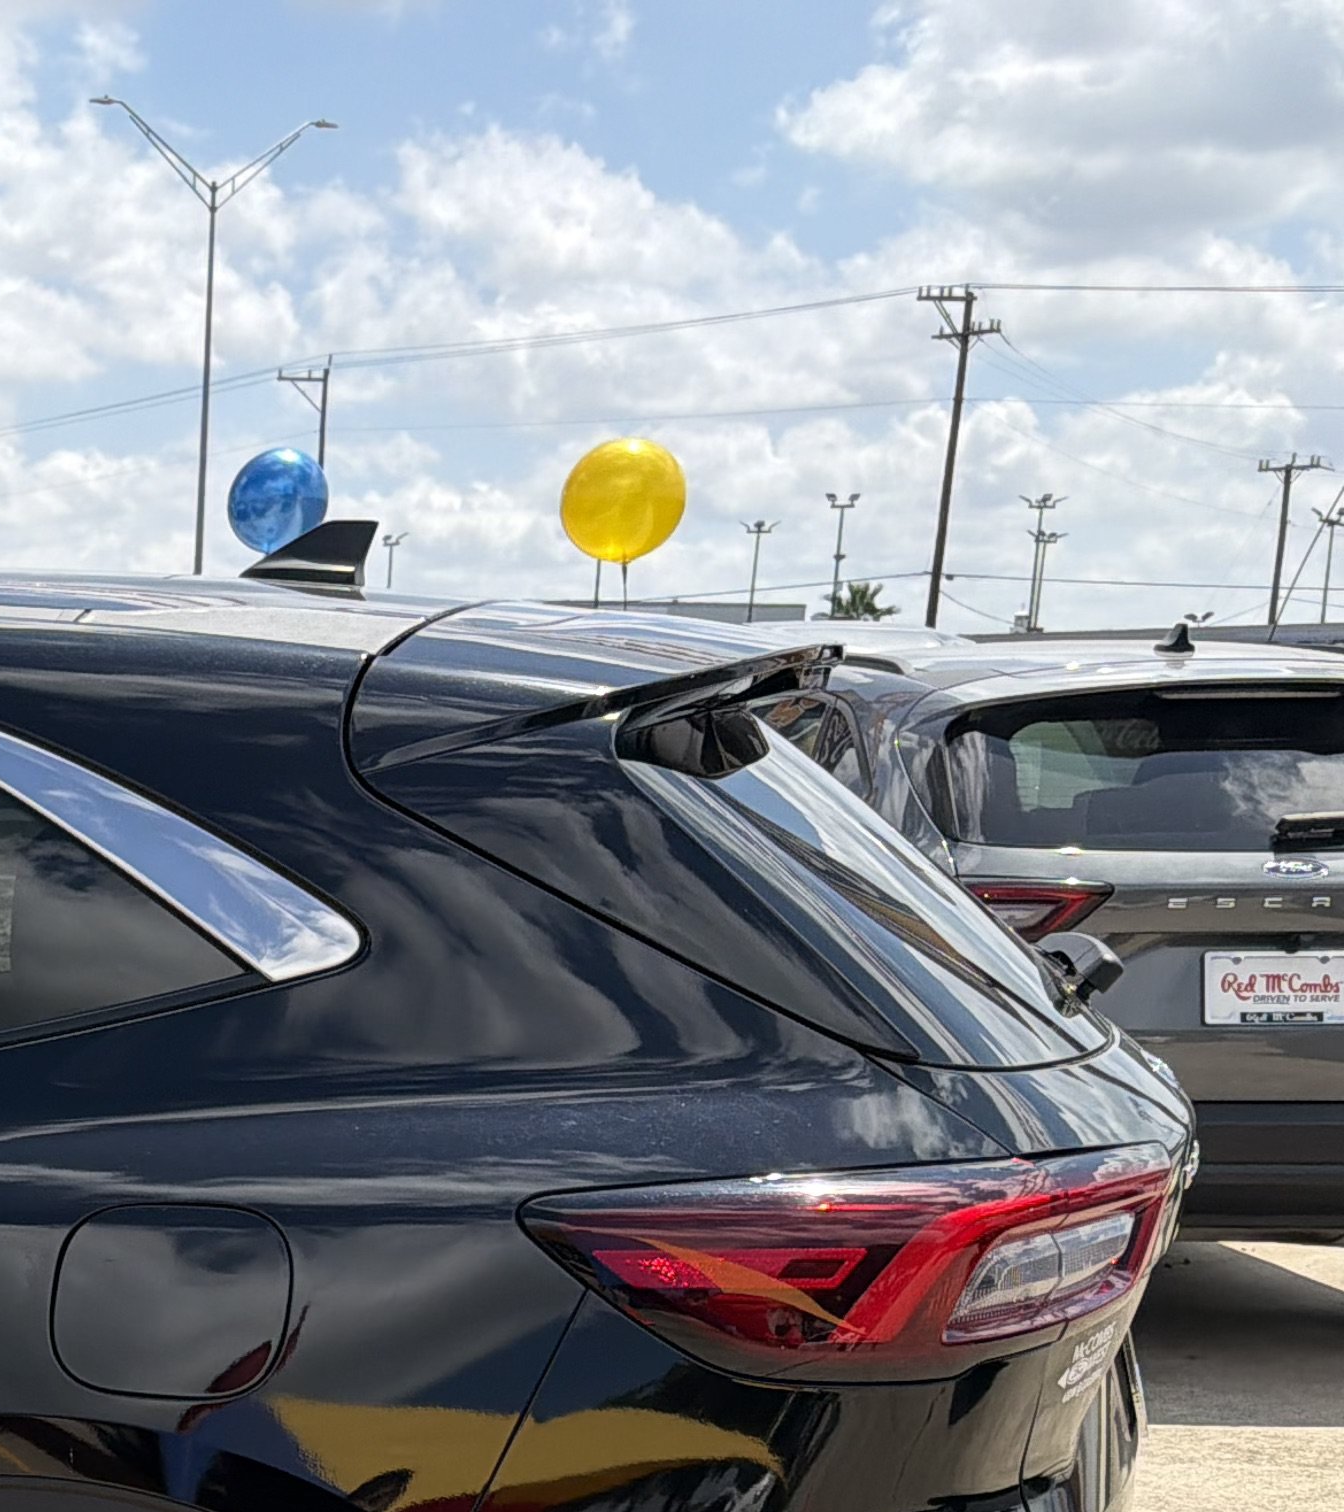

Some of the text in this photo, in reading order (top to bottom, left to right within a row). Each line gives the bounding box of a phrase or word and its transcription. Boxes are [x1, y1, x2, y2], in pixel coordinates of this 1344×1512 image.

[1220, 972, 1341, 1001] Red McCombs
[1252, 993, 1341, 1004] DRIVEN TO SERVE
